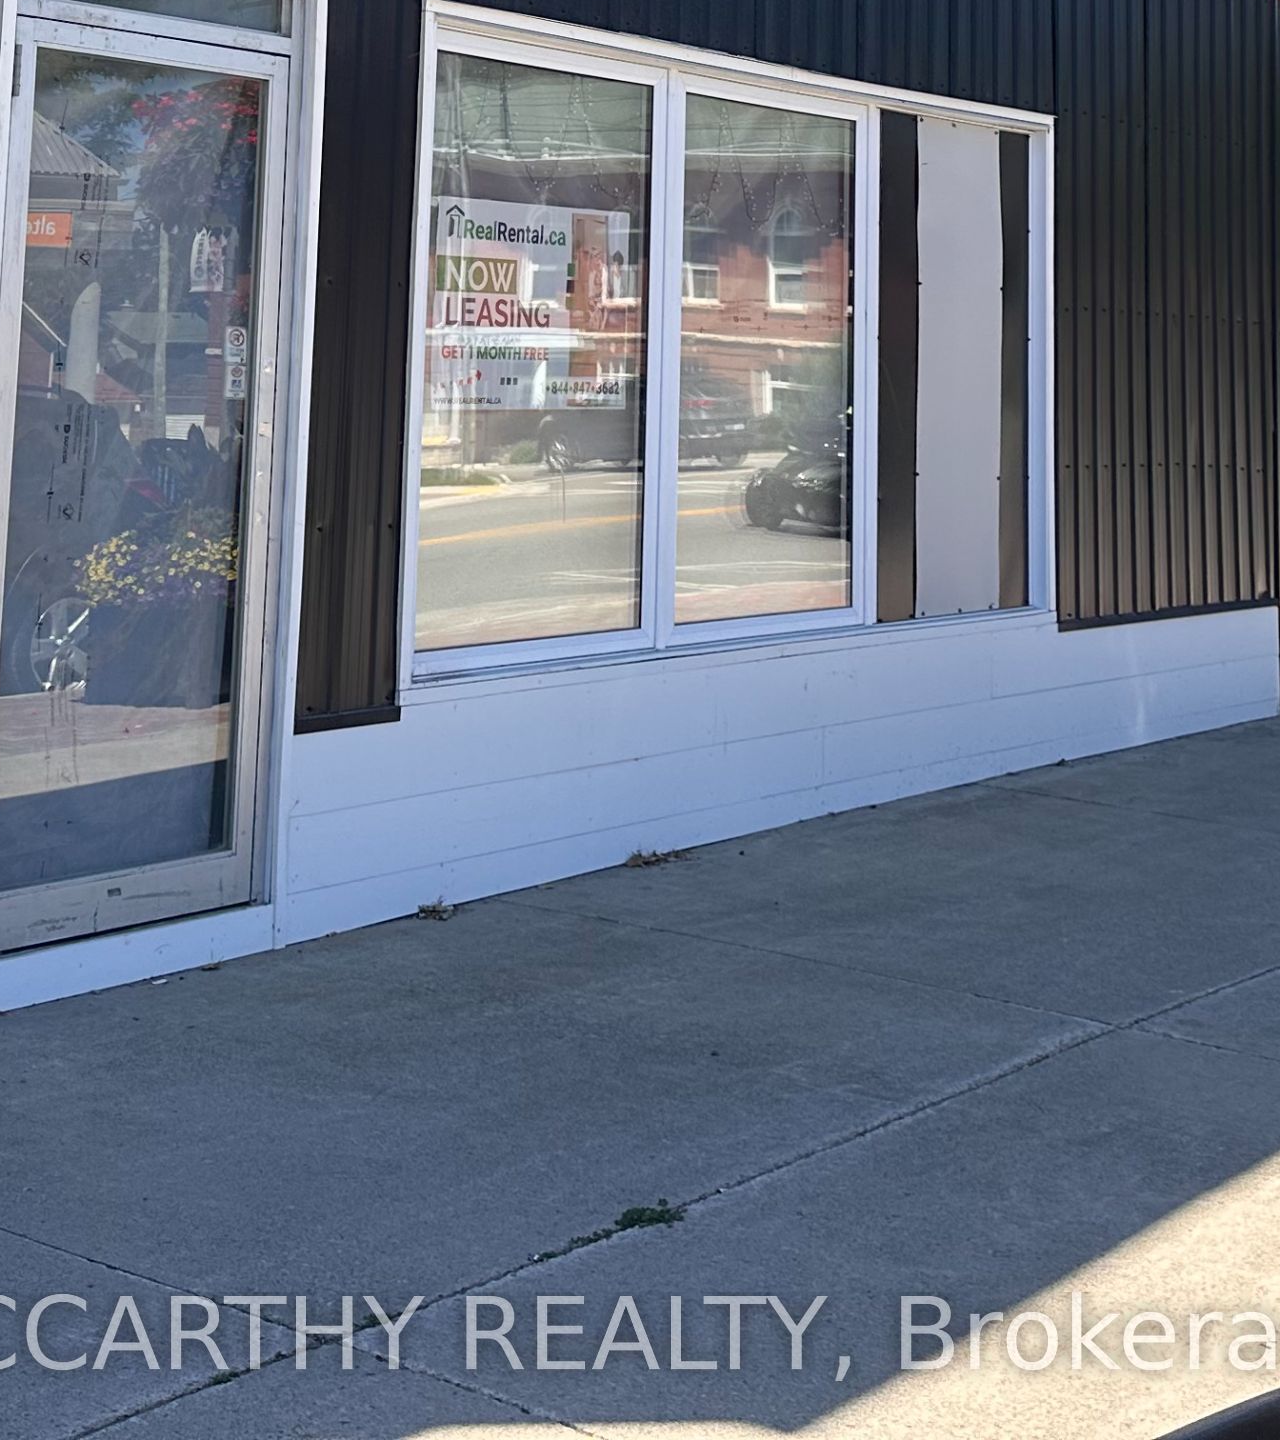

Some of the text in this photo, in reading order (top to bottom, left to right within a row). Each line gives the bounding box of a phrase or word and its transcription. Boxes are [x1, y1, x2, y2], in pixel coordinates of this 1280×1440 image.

[464, 219, 567, 247] RealRental.ca
[447, 259, 515, 293] NOW
[445, 296, 550, 328] LEASING
[442, 345, 466, 359] GET
[476, 346, 521, 360] MONTH
[523, 348, 549, 361] FREE
